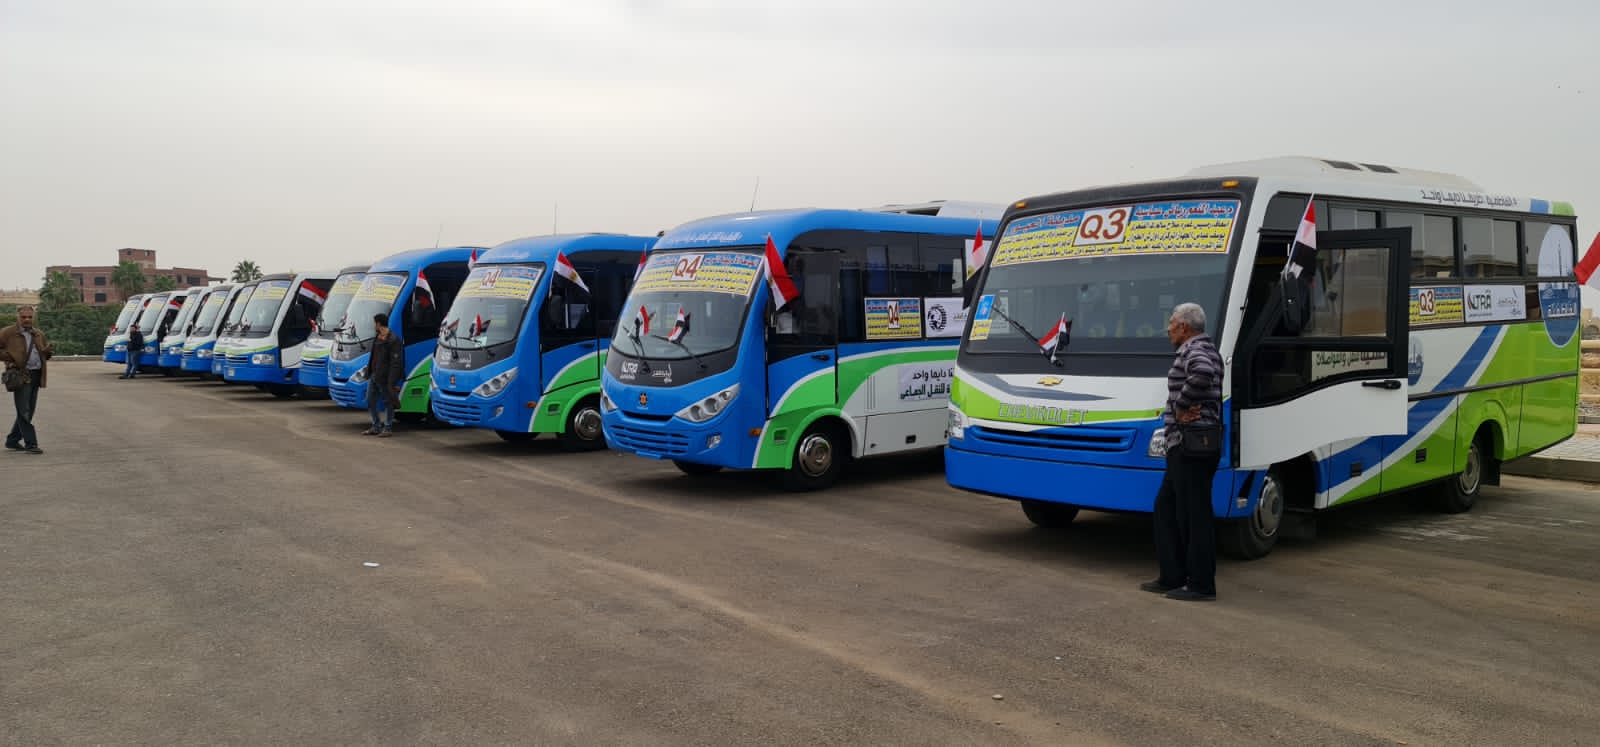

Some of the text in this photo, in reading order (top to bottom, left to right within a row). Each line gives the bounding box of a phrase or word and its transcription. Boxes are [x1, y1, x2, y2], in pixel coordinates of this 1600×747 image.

[1079, 209, 1127, 240] Q3
[675, 256, 702, 279] Q4
[1419, 290, 1434, 312] Q3
[911, 369, 929, 382] واحد
[998, 402, 1089, 425] CHEVROLET
